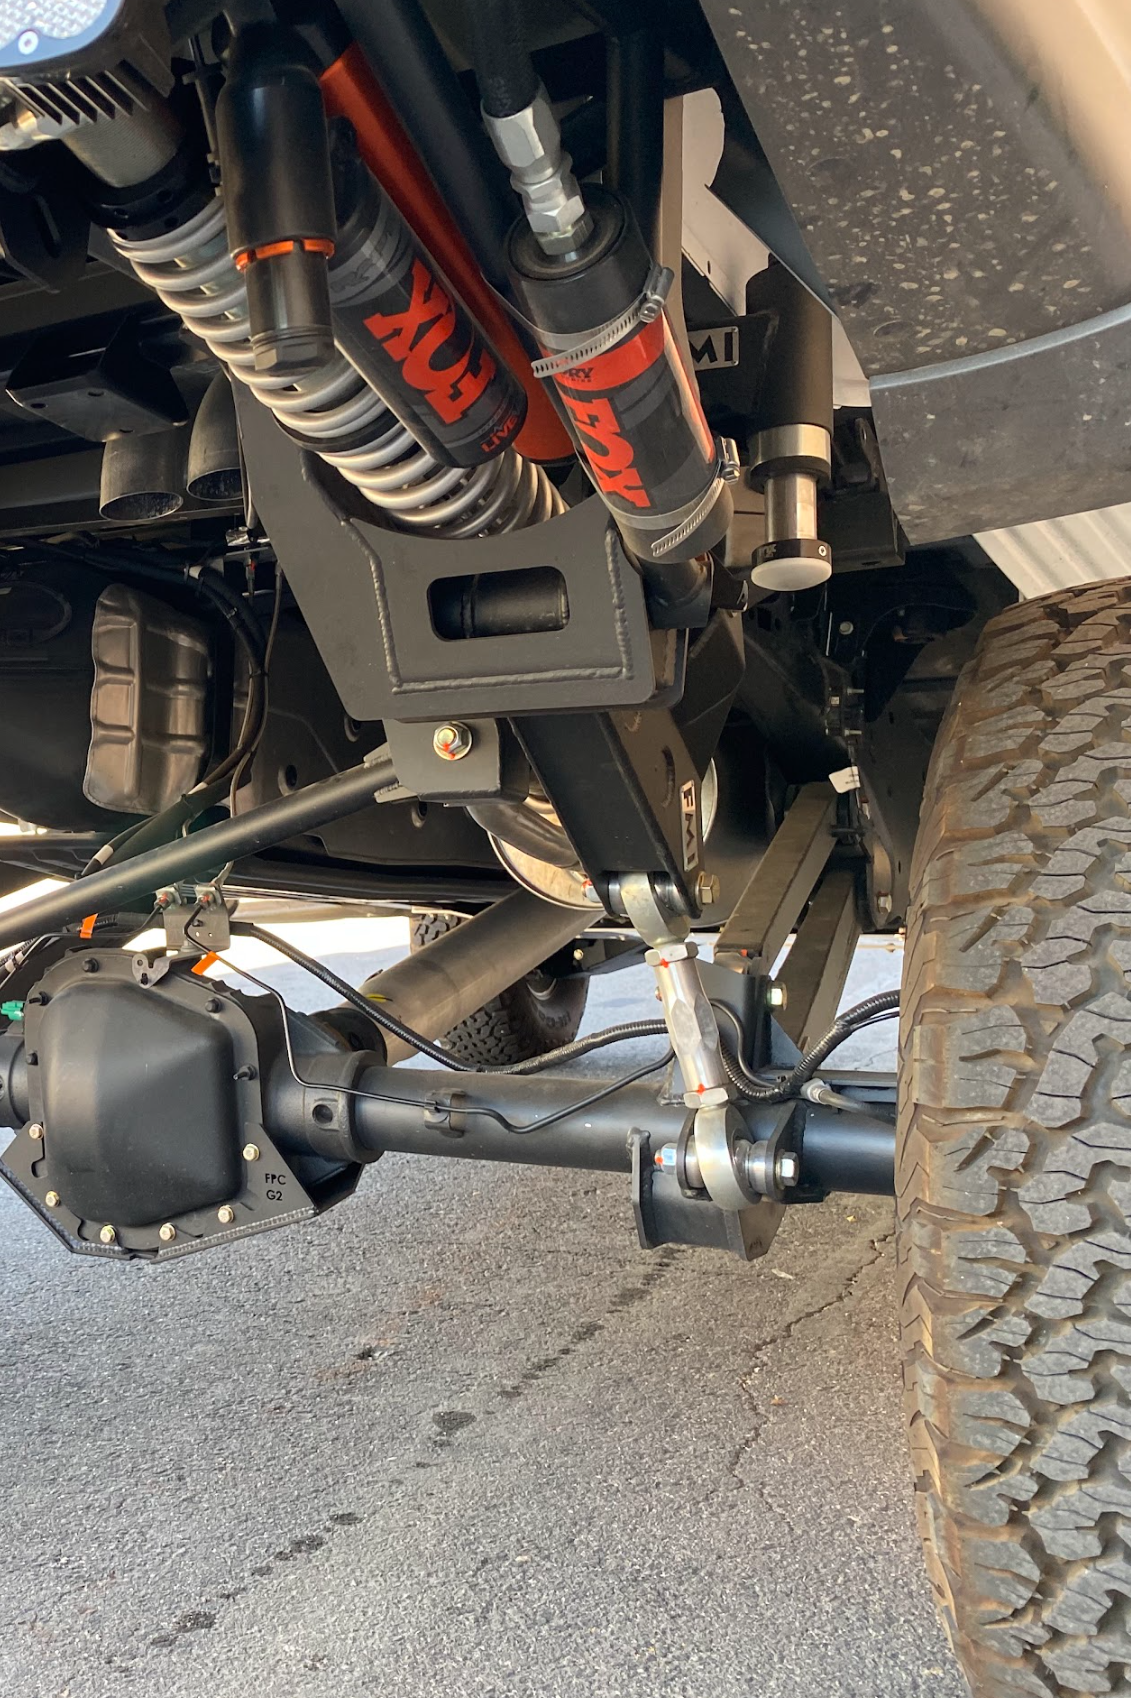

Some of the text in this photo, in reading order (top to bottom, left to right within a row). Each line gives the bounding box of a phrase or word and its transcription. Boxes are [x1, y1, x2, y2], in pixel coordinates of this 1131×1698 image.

[363, 258, 497, 424] FOX
[689, 331, 734, 364] MI
[480, 414, 518, 452] LIVE
[561, 392, 651, 507] FOX
[683, 787, 696, 866] FMI
[265, 1173, 286, 1185] FPC
[266, 1189, 283, 1201] G2
